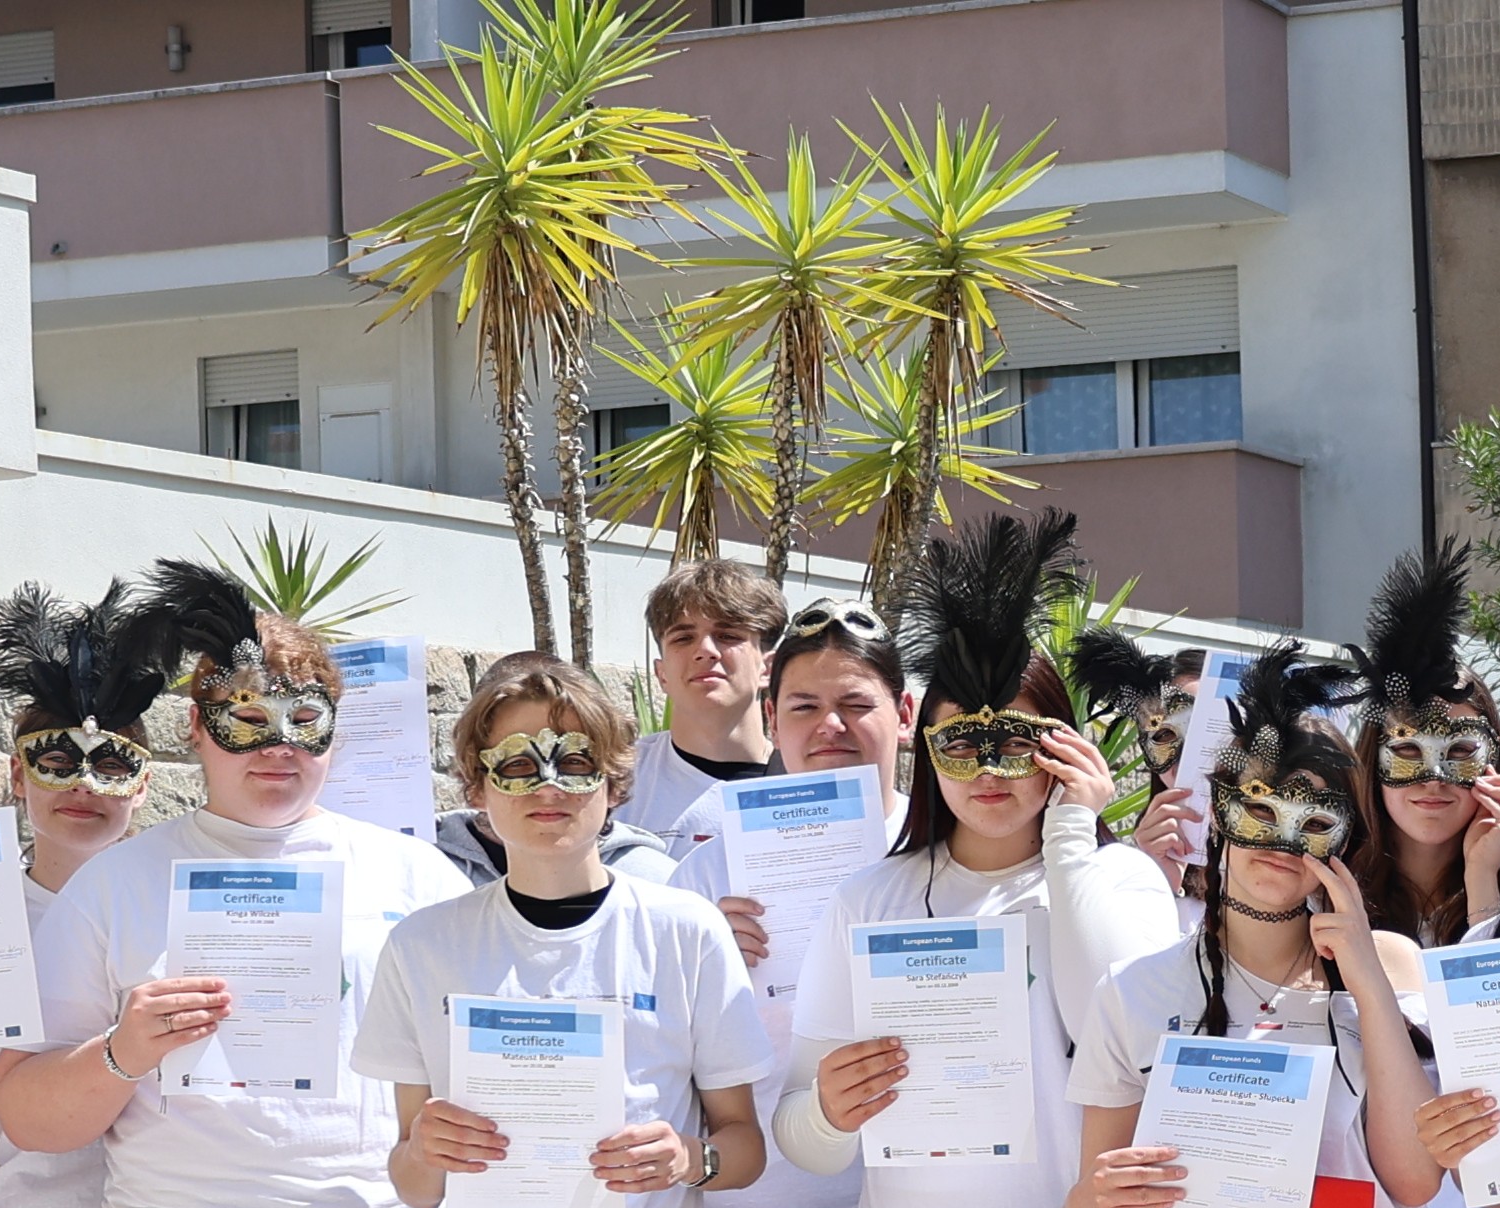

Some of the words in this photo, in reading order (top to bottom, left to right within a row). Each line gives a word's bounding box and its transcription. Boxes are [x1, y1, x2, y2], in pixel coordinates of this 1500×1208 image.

[340, 668, 375, 678] tificate
[769, 792, 796, 800] European
[772, 806, 829, 820] Certificate
[777, 825, 805, 834] Szymon
[808, 823, 828, 831] Durys
[223, 894, 284, 904] Certificate
[225, 910, 247, 918] Kinga
[903, 938, 933, 946] European
[906, 956, 967, 967] Certificate
[926, 972, 968, 981] Stefańczyk
[502, 1035, 565, 1047] Certificate
[502, 1053, 537, 1061] Mateusz
[1211, 1054, 1241, 1063] European
[1208, 1071, 1270, 1086] Certificate
[1177, 1086, 1202, 1094] Nikola
[1205, 1088, 1227, 1096] Nadia
[1230, 1091, 1252, 1099] Legut
